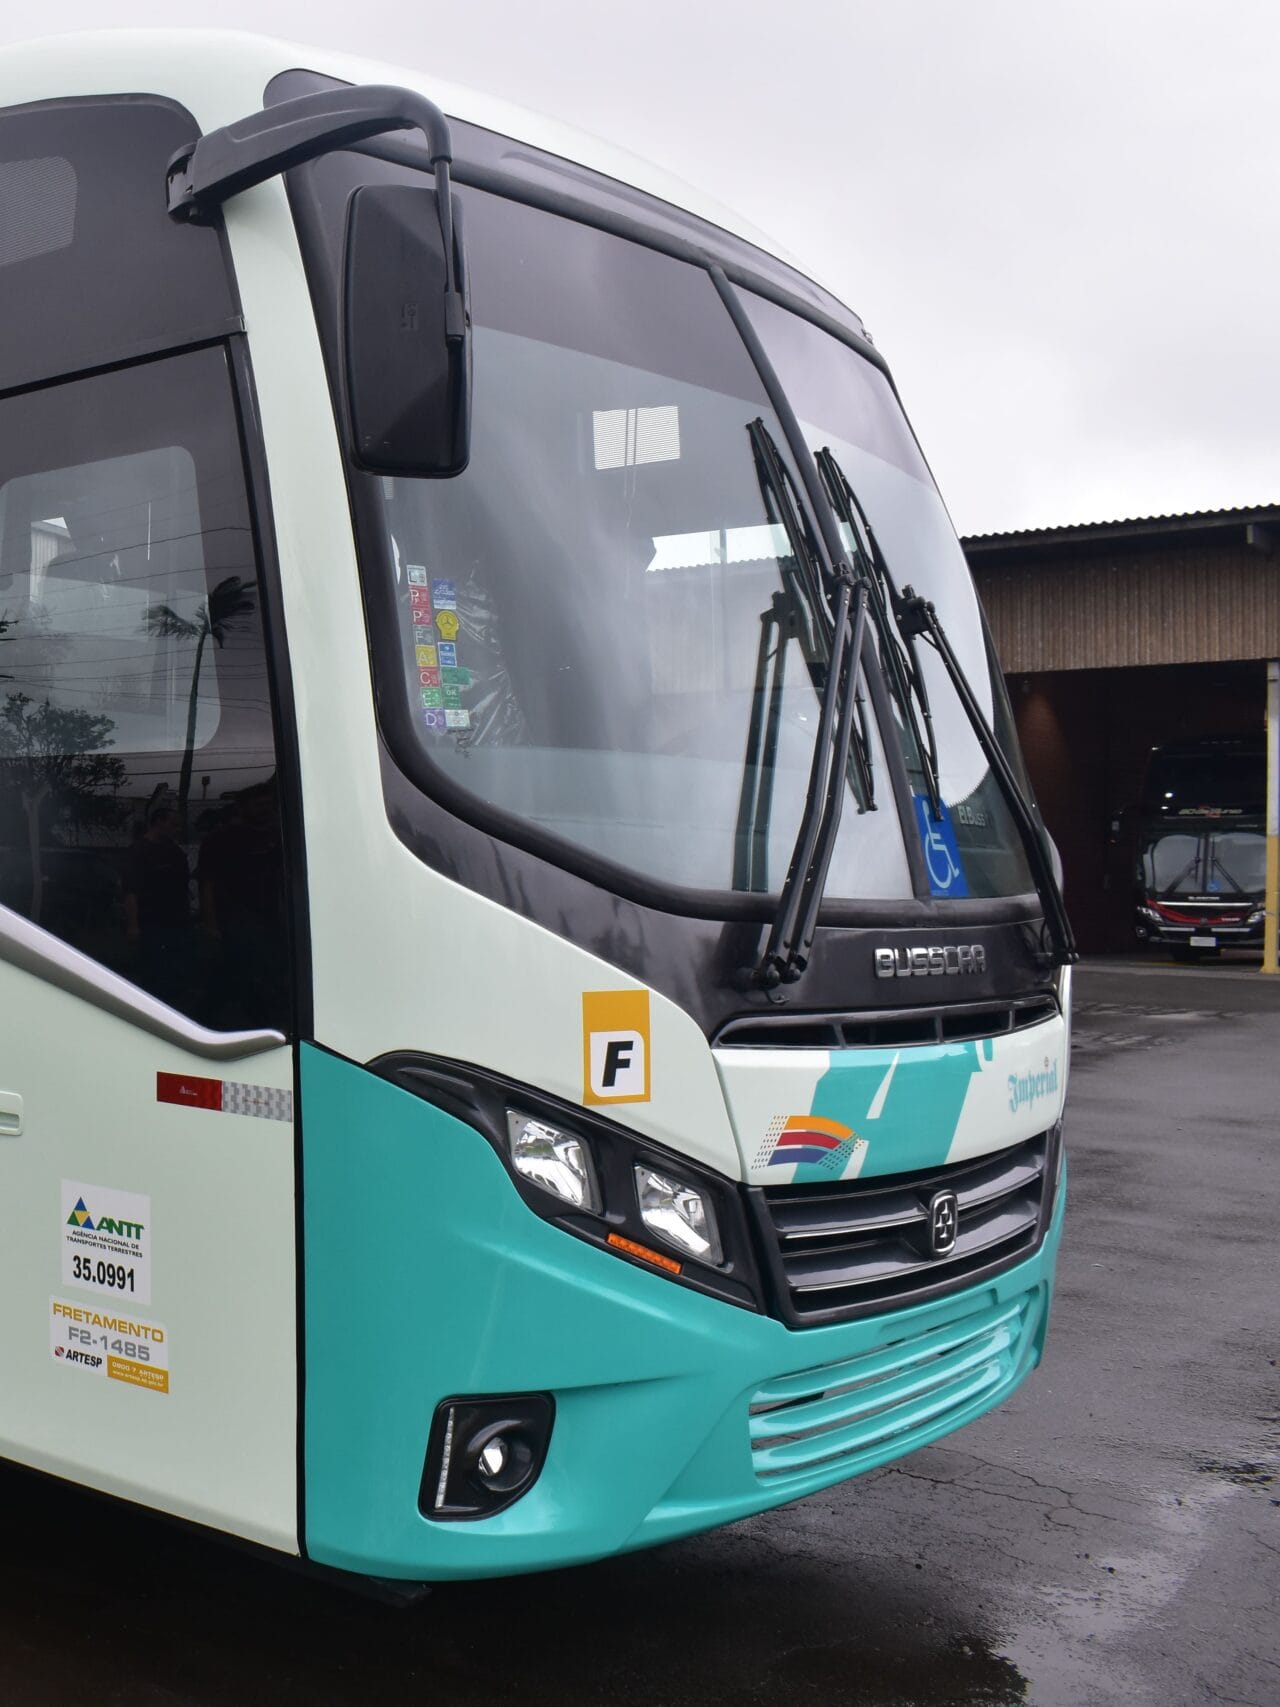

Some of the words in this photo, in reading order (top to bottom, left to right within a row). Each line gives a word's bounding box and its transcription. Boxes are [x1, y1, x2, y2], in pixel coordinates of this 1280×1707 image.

[875, 945, 985, 978] BUSSCAR
[602, 1041, 634, 1088] F
[72, 1230, 97, 1241] AGÊNCIA
[98, 1236, 130, 1249] NACIONAL
[95, 1217, 144, 1240] ANTT
[66, 1236, 106, 1250] TRANSPORTES
[107, 1245, 142, 1258] TERRESTRES
[73, 1255, 134, 1292] 35.0991
[52, 1302, 164, 1343] FRETAMENTO
[65, 1349, 103, 1368] ARTESP
